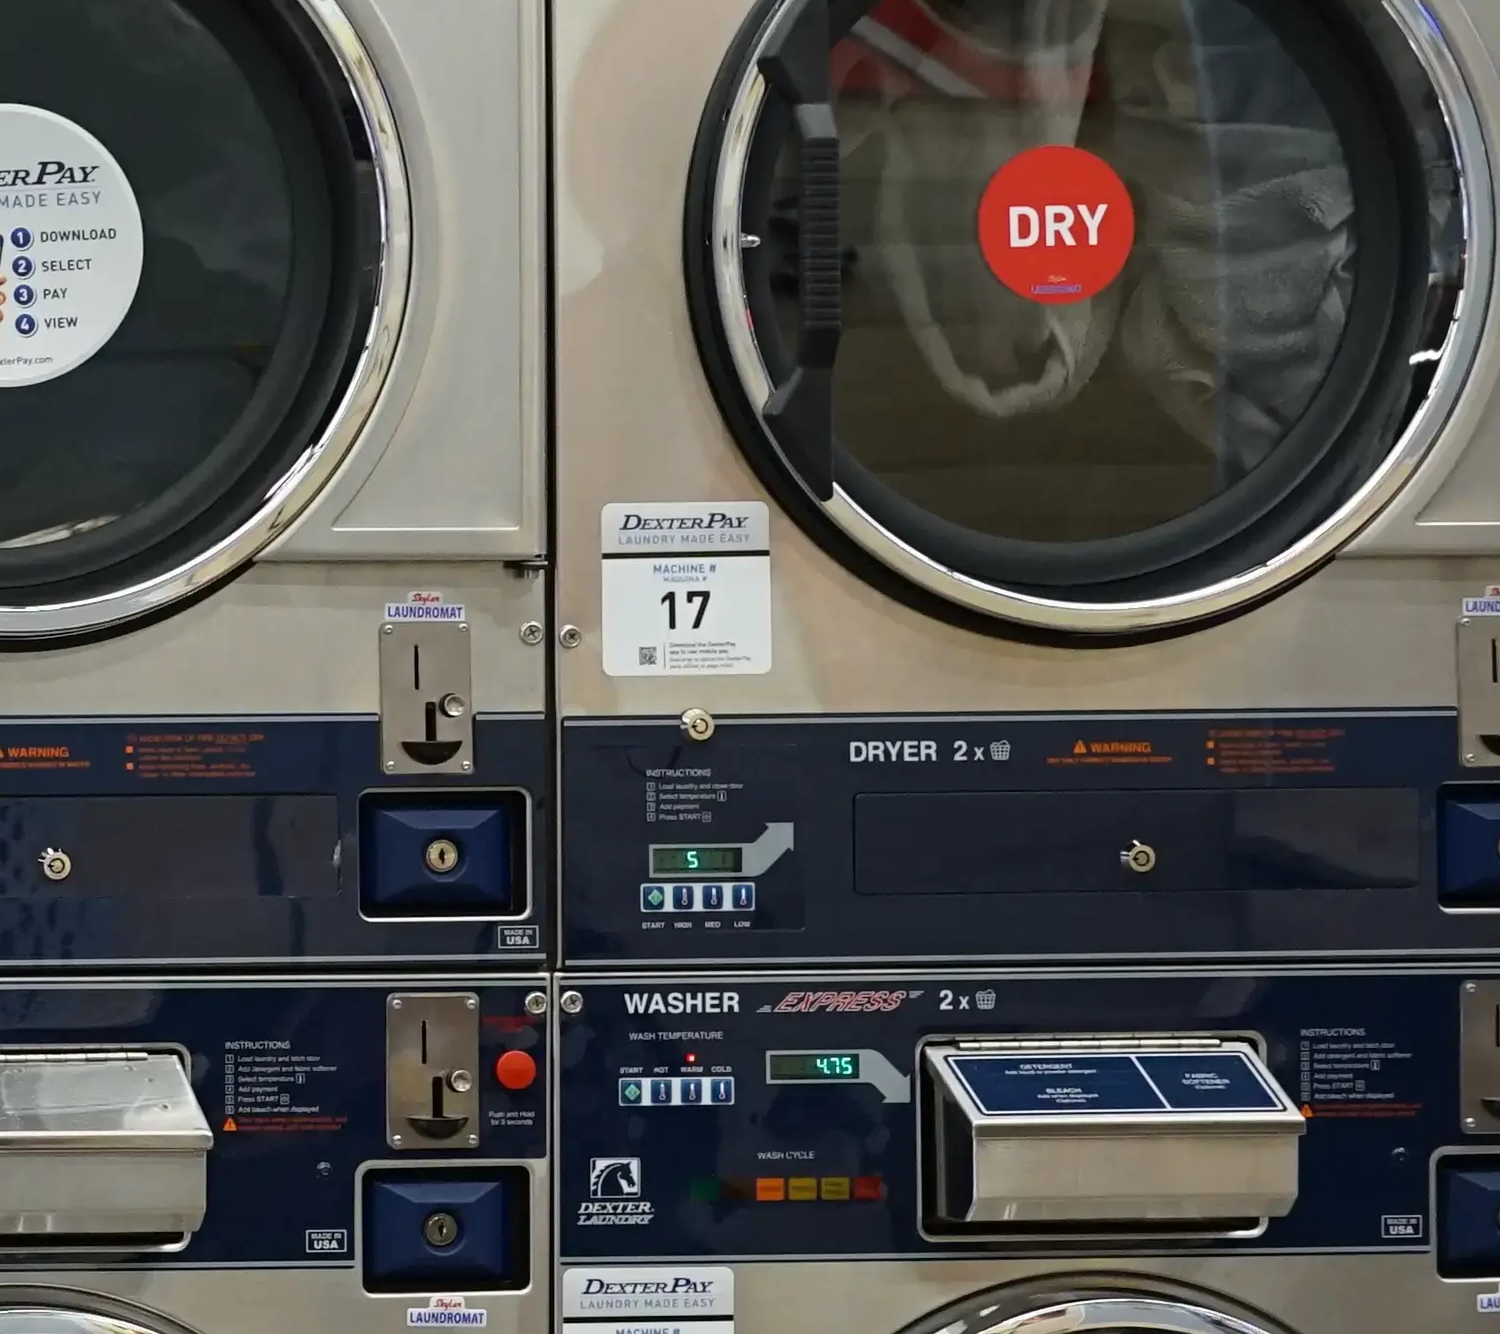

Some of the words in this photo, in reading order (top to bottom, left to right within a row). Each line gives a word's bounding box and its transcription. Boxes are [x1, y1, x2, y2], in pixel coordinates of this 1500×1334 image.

[56, 191, 101, 207] EASY
[1010, 204, 1107, 247] DRY
[17, 232, 24, 244] 1
[40, 229, 117, 243] DOWNLOAD
[18, 261, 27, 273] 2
[42, 259, 92, 272] SELECT
[19, 289, 28, 301] 3
[43, 289, 67, 300] PAY
[20, 318, 30, 330] 4
[44, 318, 78, 329] VIEW
[388, 606, 463, 618] LAUNDROMAT
[661, 591, 710, 629] 17
[850, 741, 936, 761] DRYER
[625, 992, 739, 1013] WASHER
[314, 1240, 338, 1249] USA
[410, 1312, 484, 1324] LAUNDROMAT
